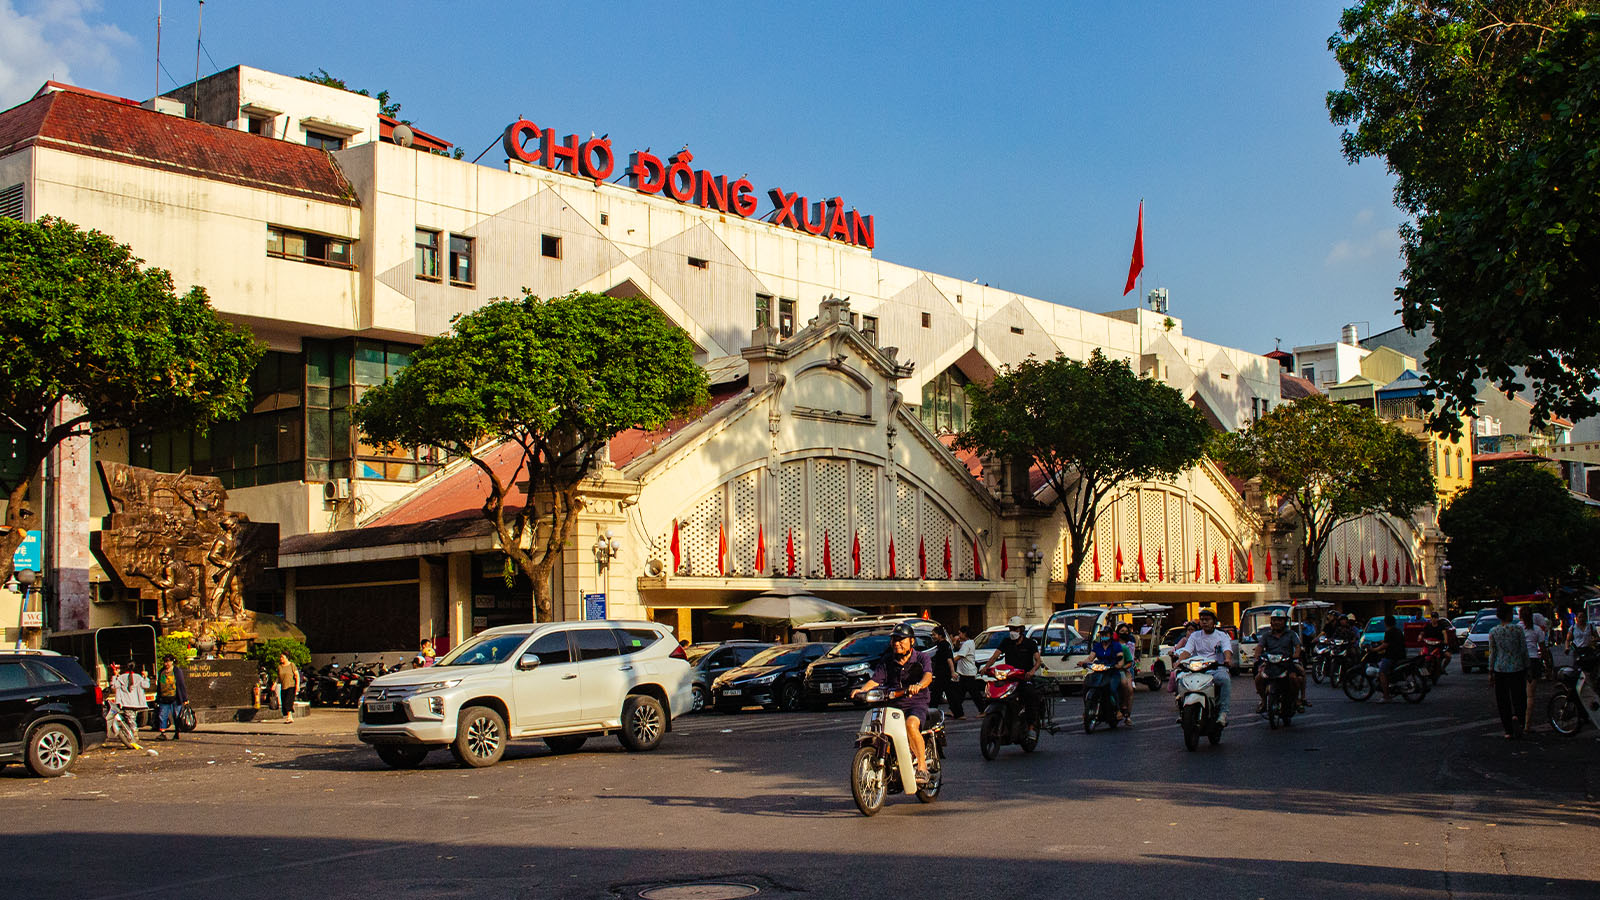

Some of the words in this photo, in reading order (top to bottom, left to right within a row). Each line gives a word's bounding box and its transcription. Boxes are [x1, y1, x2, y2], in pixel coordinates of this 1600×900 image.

[503, 119, 615, 187] CHỢ
[625, 149, 758, 217] ĐỒNG
[768, 186, 875, 249] XUÂN
